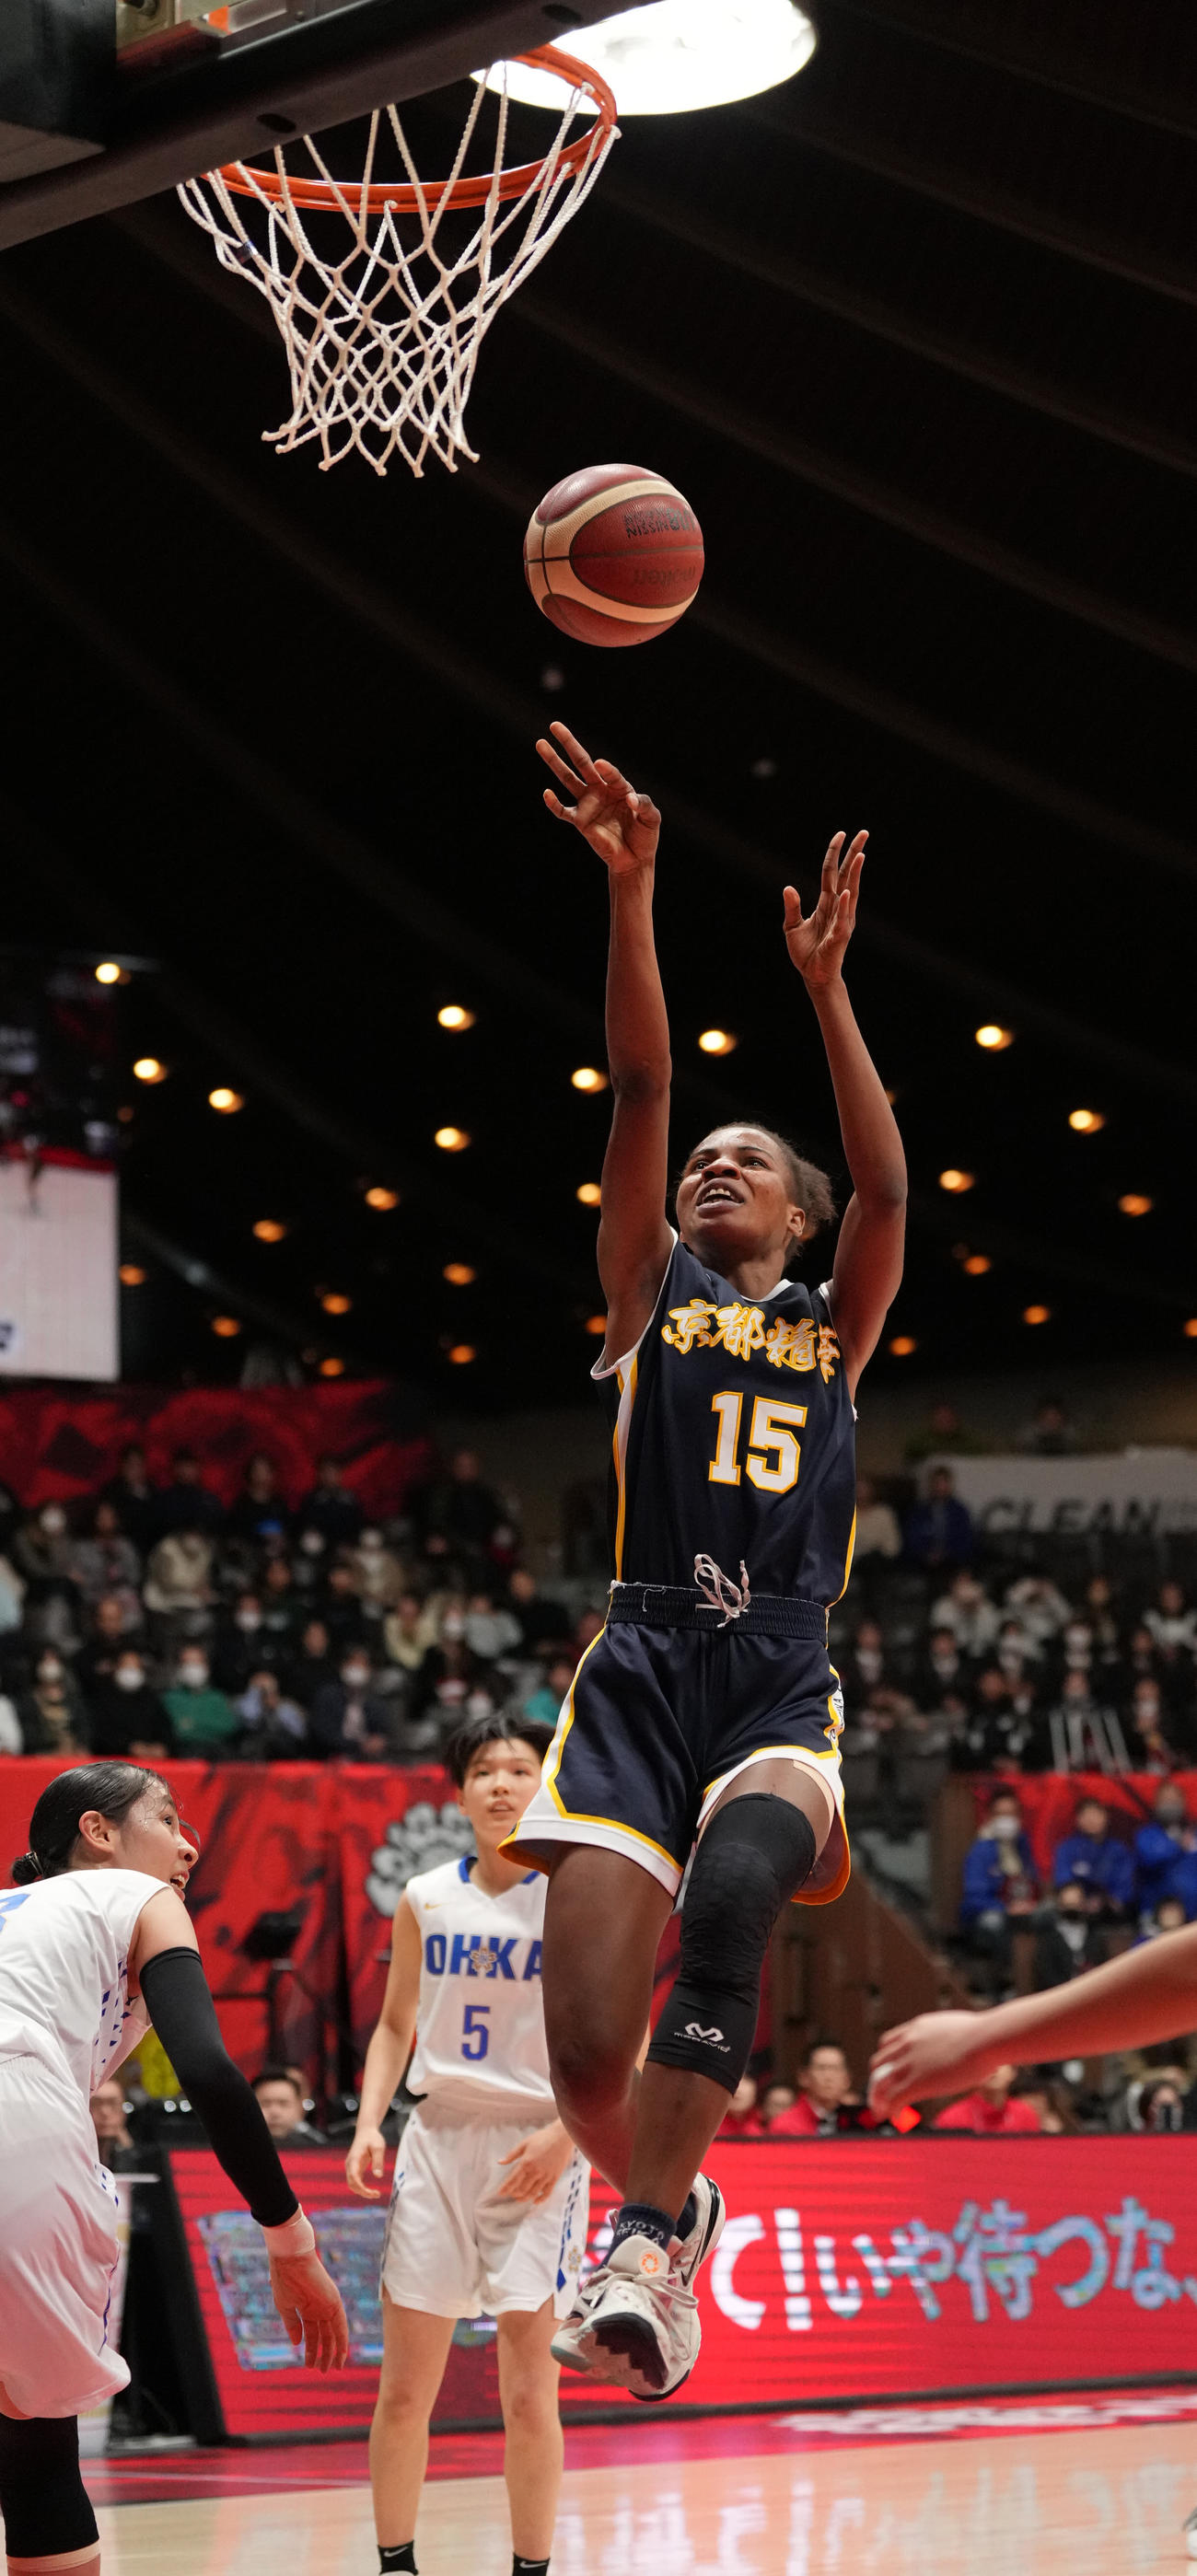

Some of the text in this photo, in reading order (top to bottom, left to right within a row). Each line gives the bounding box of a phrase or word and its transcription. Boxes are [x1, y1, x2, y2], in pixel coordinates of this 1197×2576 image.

[708, 1391, 808, 1494] 15
[425, 1933, 542, 1981] OHKA
[461, 2005, 491, 2061] 5
[620, 2220, 665, 2241] KYOTO
